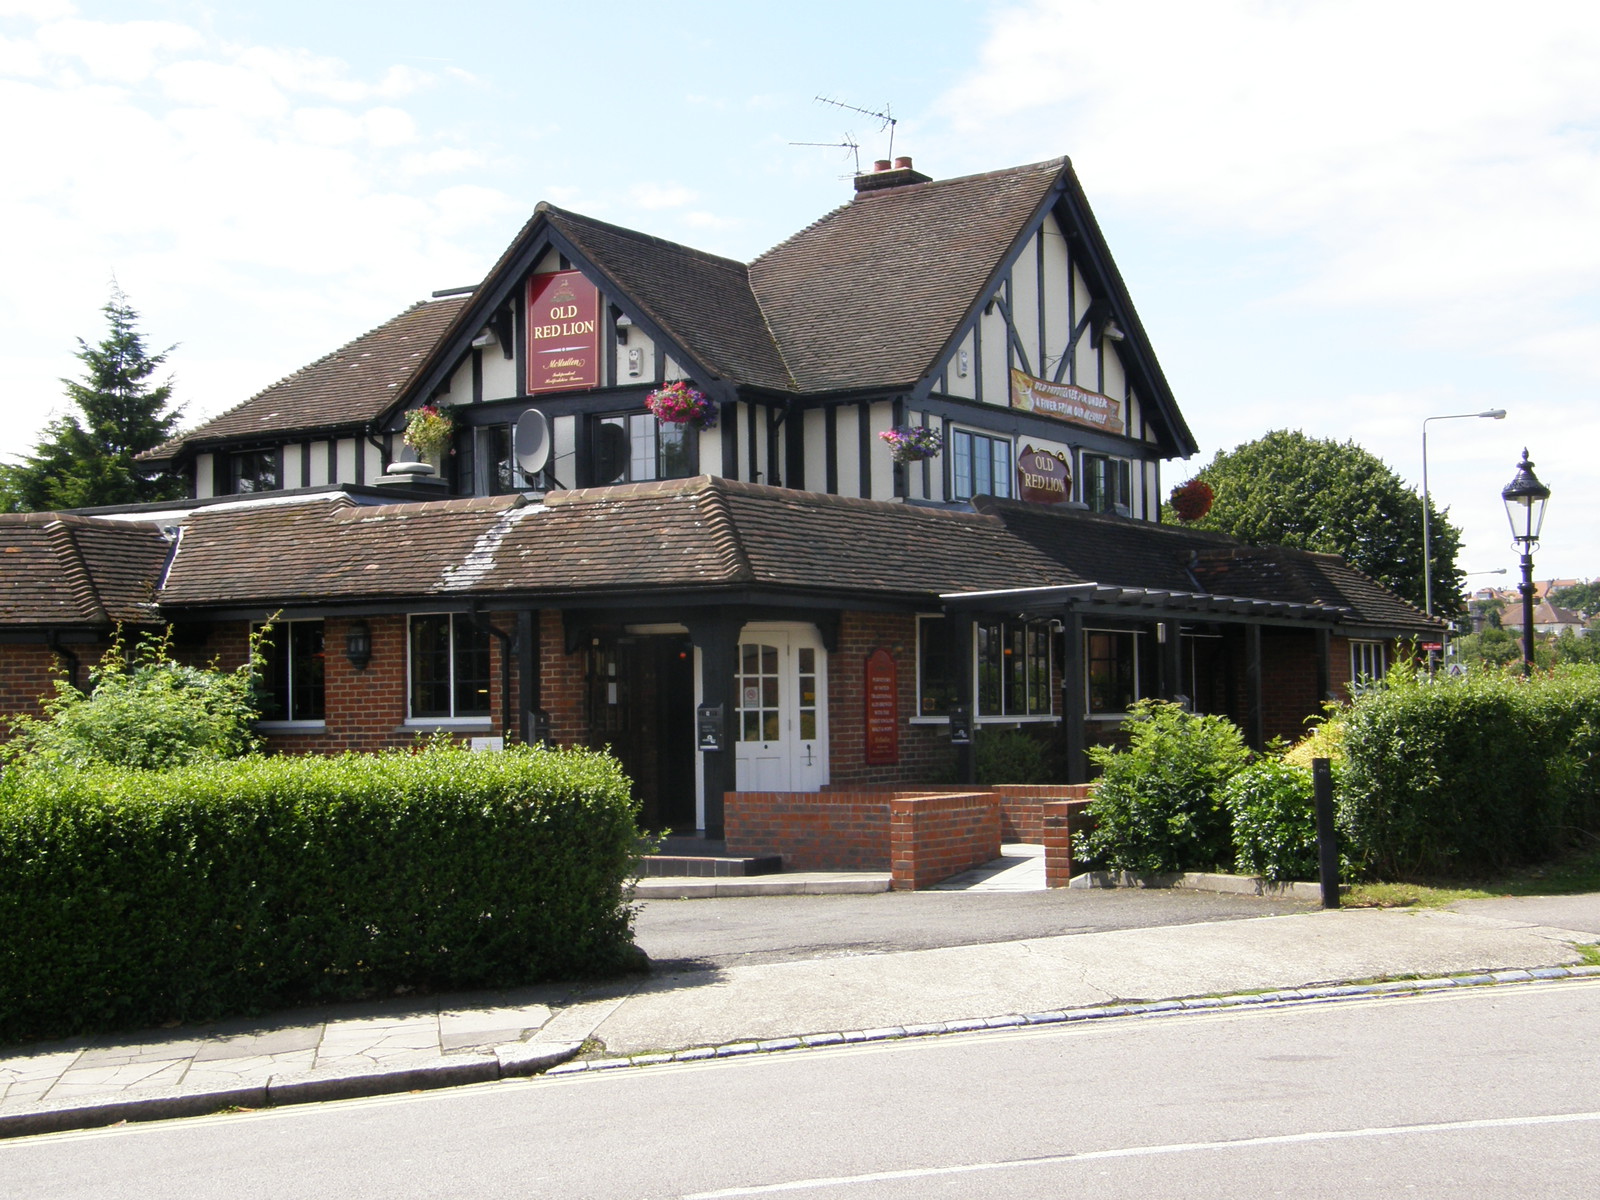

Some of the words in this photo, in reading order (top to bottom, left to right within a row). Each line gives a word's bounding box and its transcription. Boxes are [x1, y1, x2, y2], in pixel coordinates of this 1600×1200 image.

[550, 305, 578, 320] OLD
[534, 324, 561, 339] RED
[563, 320, 595, 336] LION
[1040, 398, 1057, 411] FIVER
[1035, 455, 1054, 472] OLD
[1025, 473, 1045, 489] RED
[1045, 477, 1065, 493] LION
